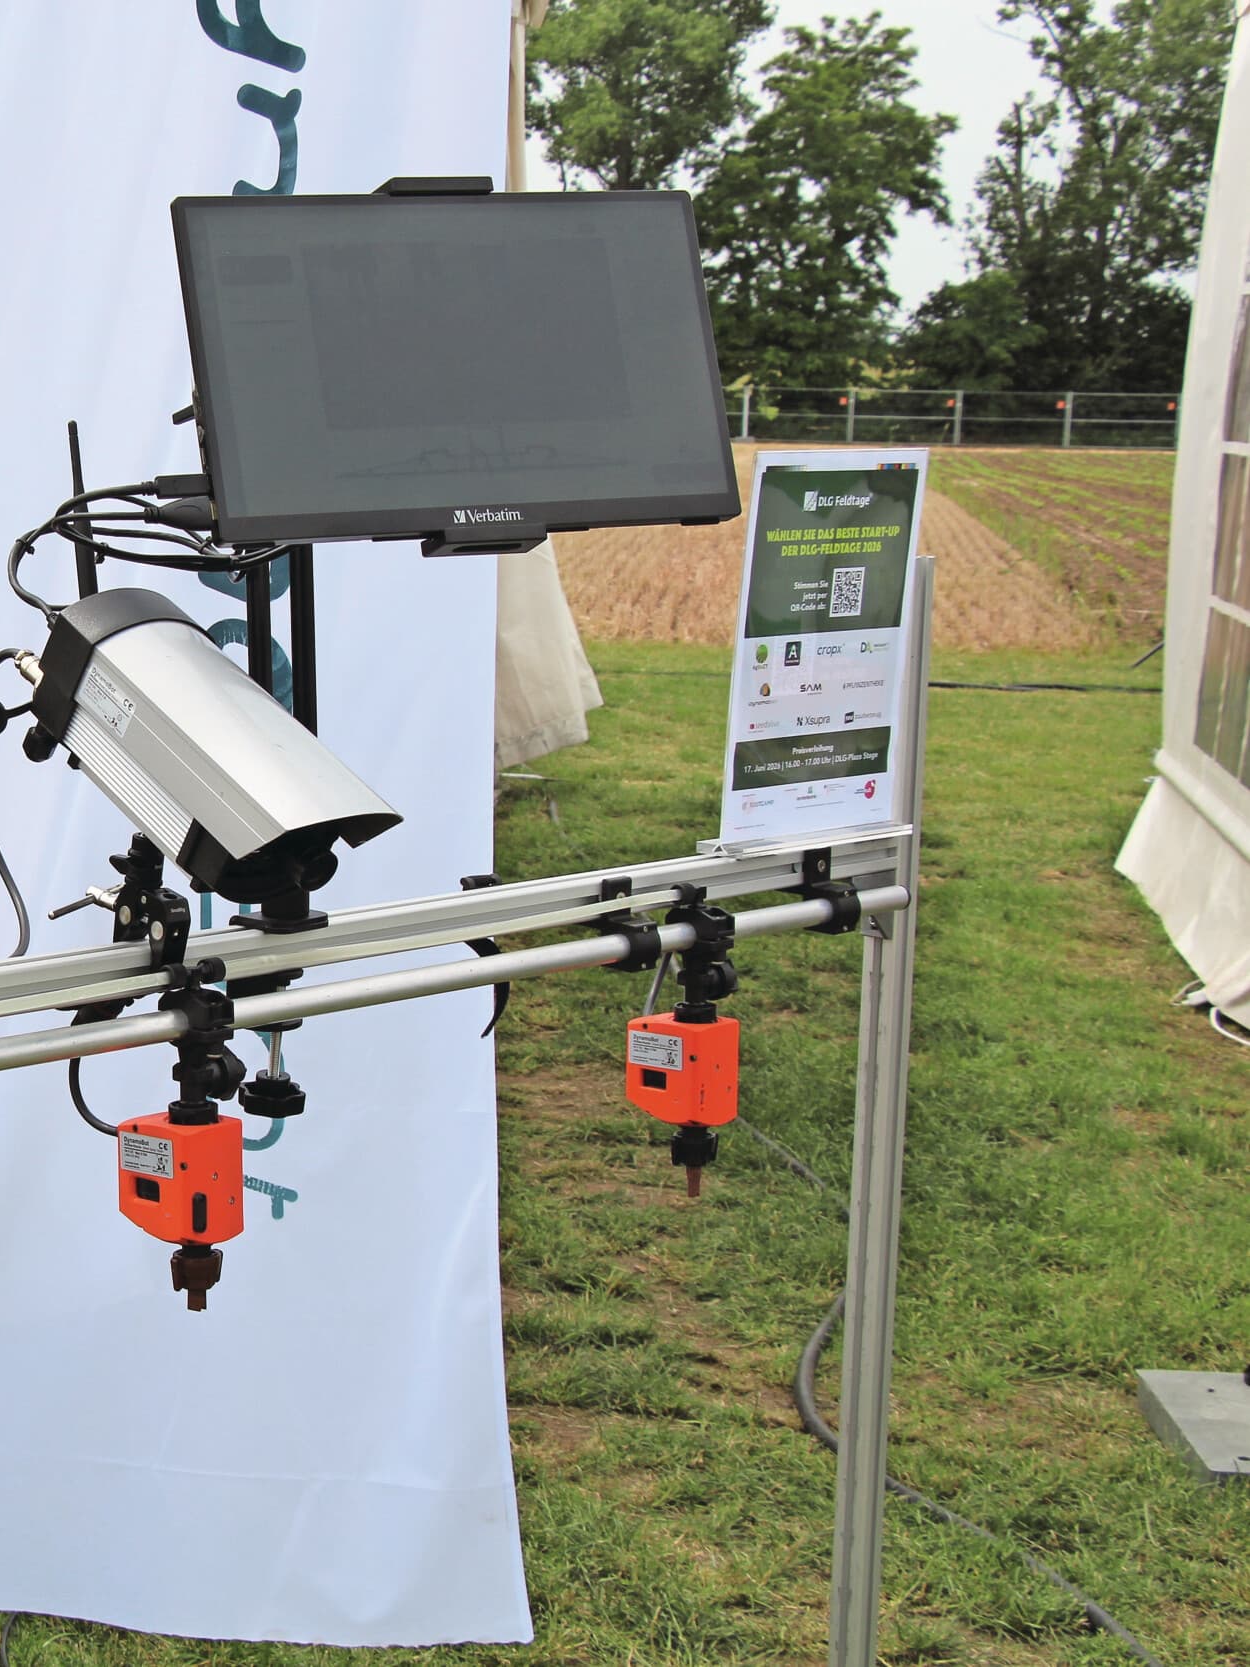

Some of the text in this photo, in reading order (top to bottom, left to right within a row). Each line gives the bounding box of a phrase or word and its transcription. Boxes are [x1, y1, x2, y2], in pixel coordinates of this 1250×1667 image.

[818, 494, 870, 508] DLG Feldtage
[466, 508, 521, 524] Verbatim
[803, 529, 816, 540] SIE
[818, 528, 834, 539] DAS
[836, 527, 860, 539] BESTE
[861, 525, 900, 538] START-UP
[782, 545, 798, 557] DER
